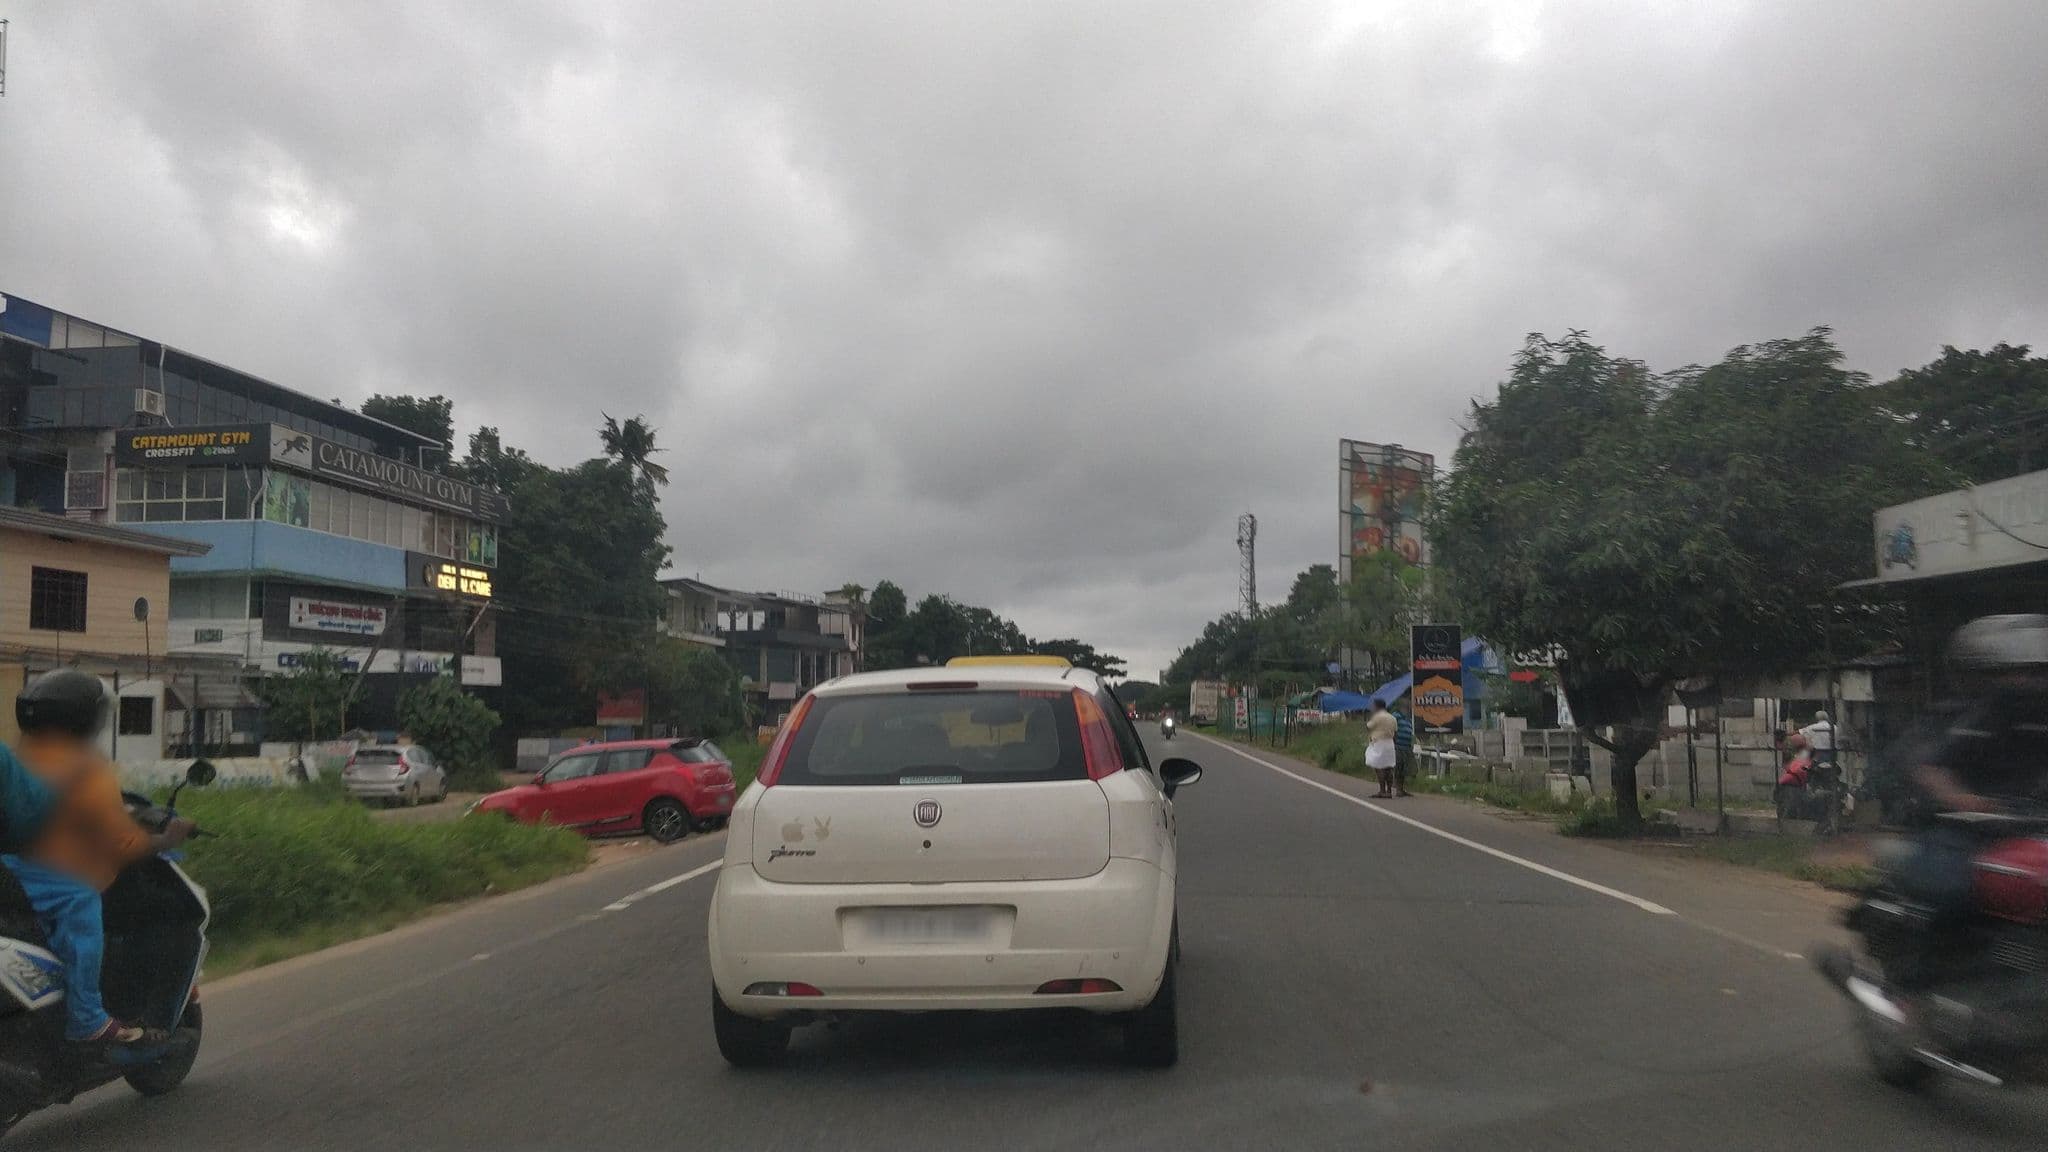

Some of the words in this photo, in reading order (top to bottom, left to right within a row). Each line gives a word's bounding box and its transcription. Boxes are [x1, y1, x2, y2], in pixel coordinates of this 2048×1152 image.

[131, 433, 217, 449] CATAMOUNT
[220, 431, 251, 445] GYM
[145, 446, 196, 458] CROSSFIT
[319, 442, 434, 494] CATAMOUNT
[437, 478, 473, 506] GYM
[920, 806, 936, 820] FIAT
